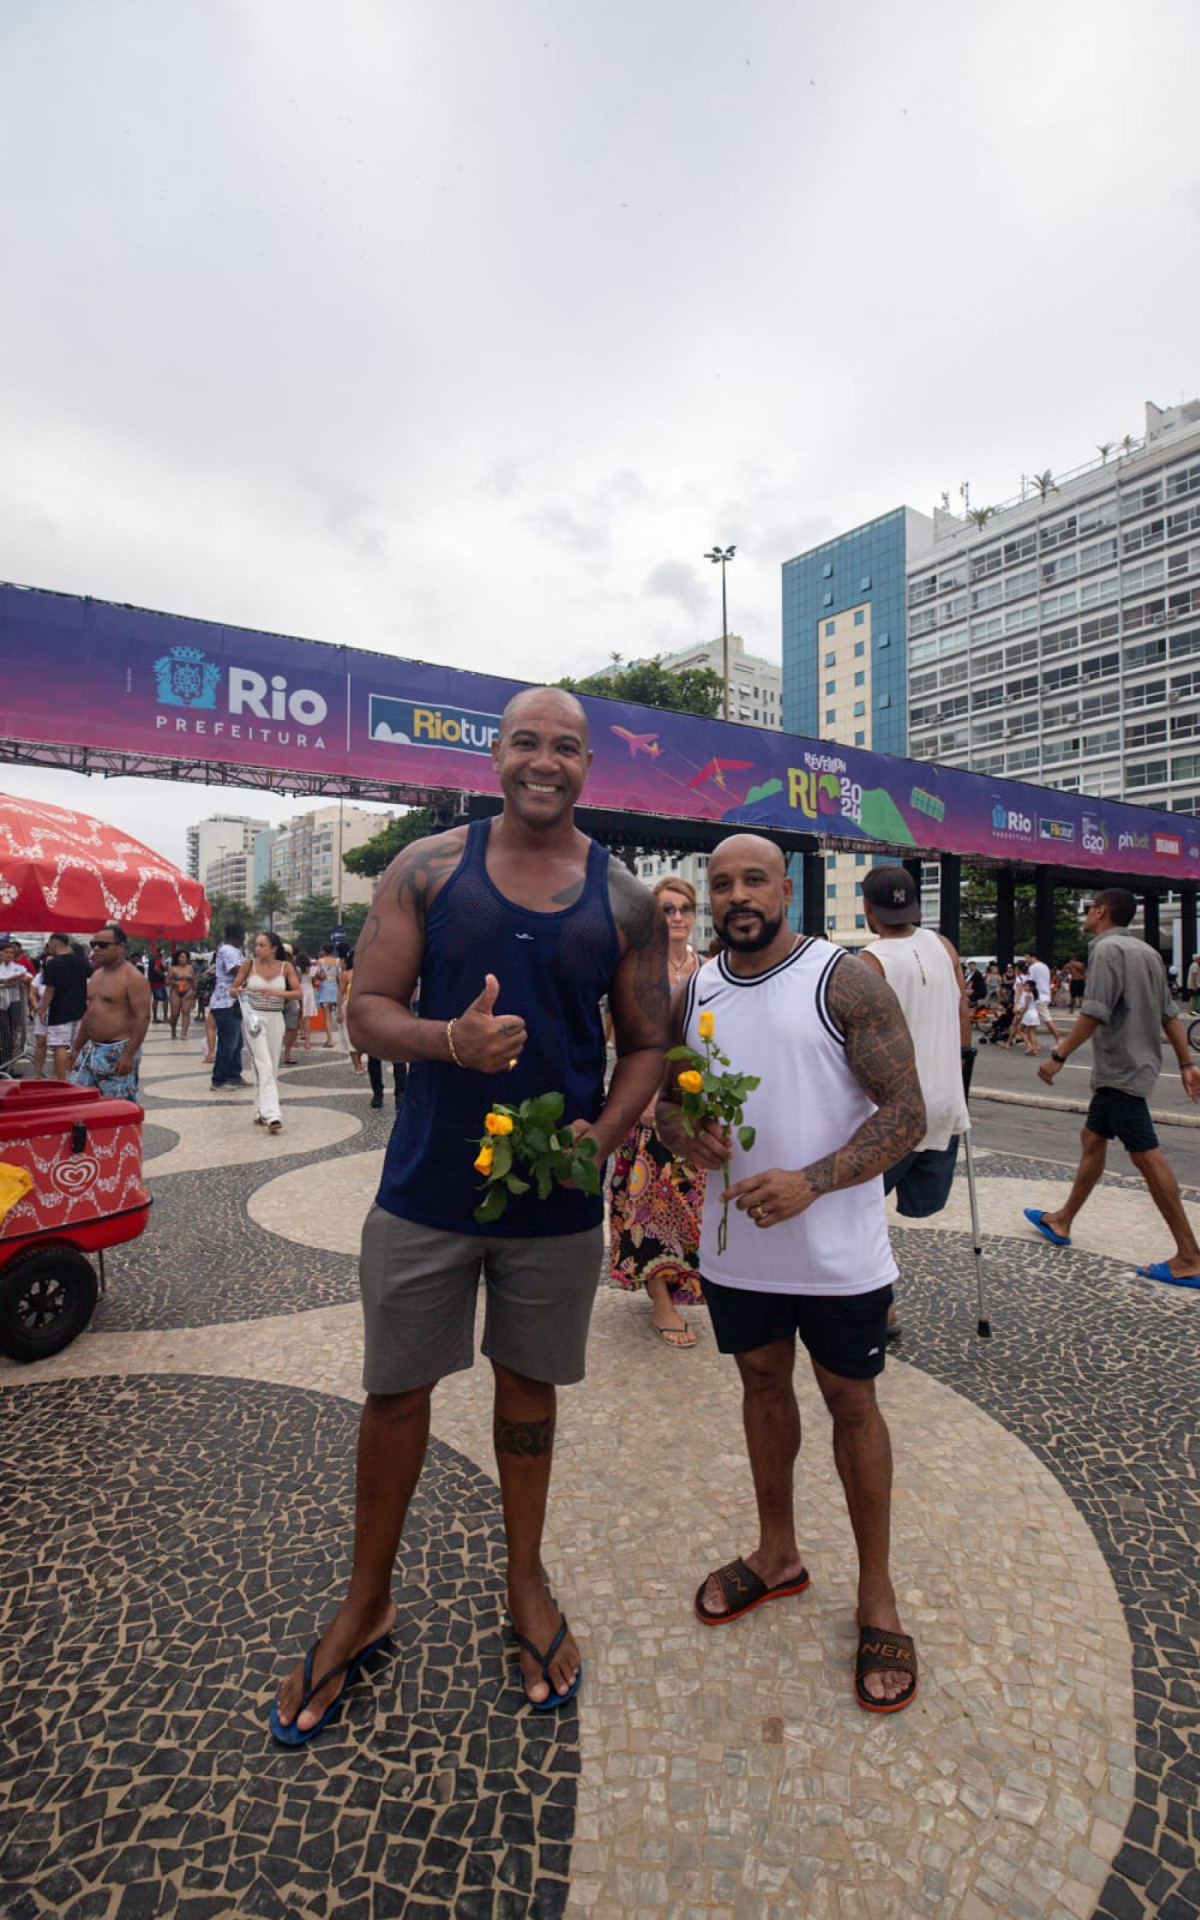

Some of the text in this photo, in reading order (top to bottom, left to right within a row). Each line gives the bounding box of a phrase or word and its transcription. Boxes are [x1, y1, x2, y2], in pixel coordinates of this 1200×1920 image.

[229, 667, 327, 726] Rio
[156, 716, 325, 749] PREFEITURA
[414, 708, 499, 748] Riotur
[841, 777, 862, 804] 20
[841, 797, 862, 825] 24
[1008, 811, 1031, 833] Rio
[1082, 834, 1105, 852] G20
[862, 1643, 911, 1661] NER
